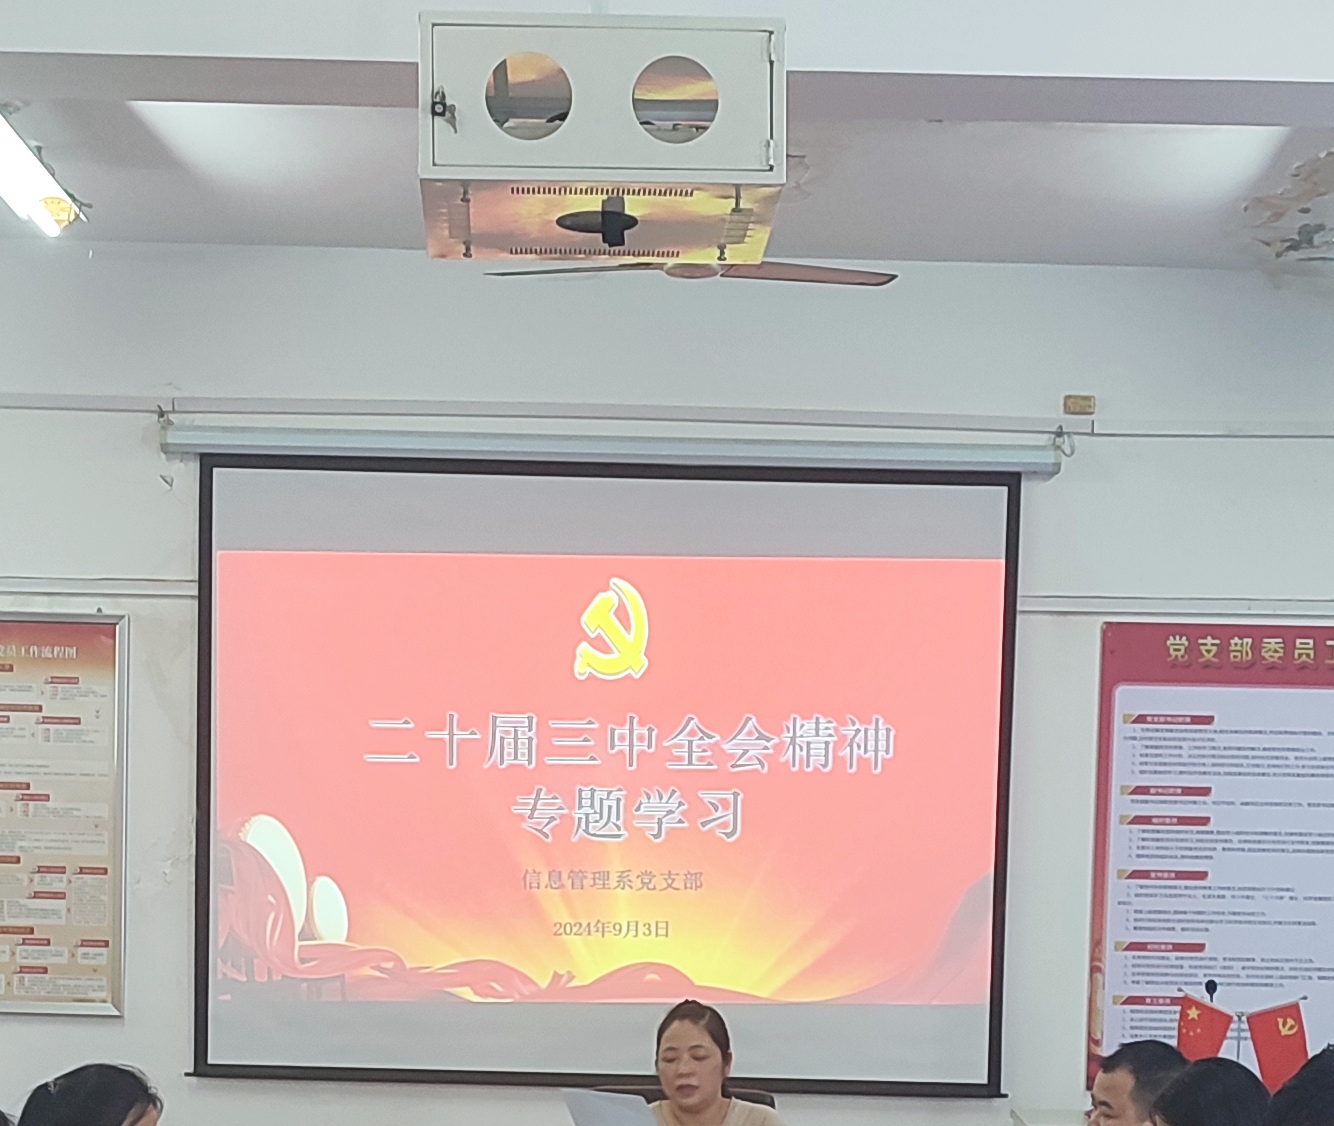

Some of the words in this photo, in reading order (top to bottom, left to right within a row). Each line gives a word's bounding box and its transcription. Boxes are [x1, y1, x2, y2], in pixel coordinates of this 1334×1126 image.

[364, 712, 895, 773] 二十届三中全会精神
[511, 786, 744, 842] 专题学习
[521, 868, 704, 892] 信息管理系党支部
[552, 919, 670, 939] 2024年9月3日
